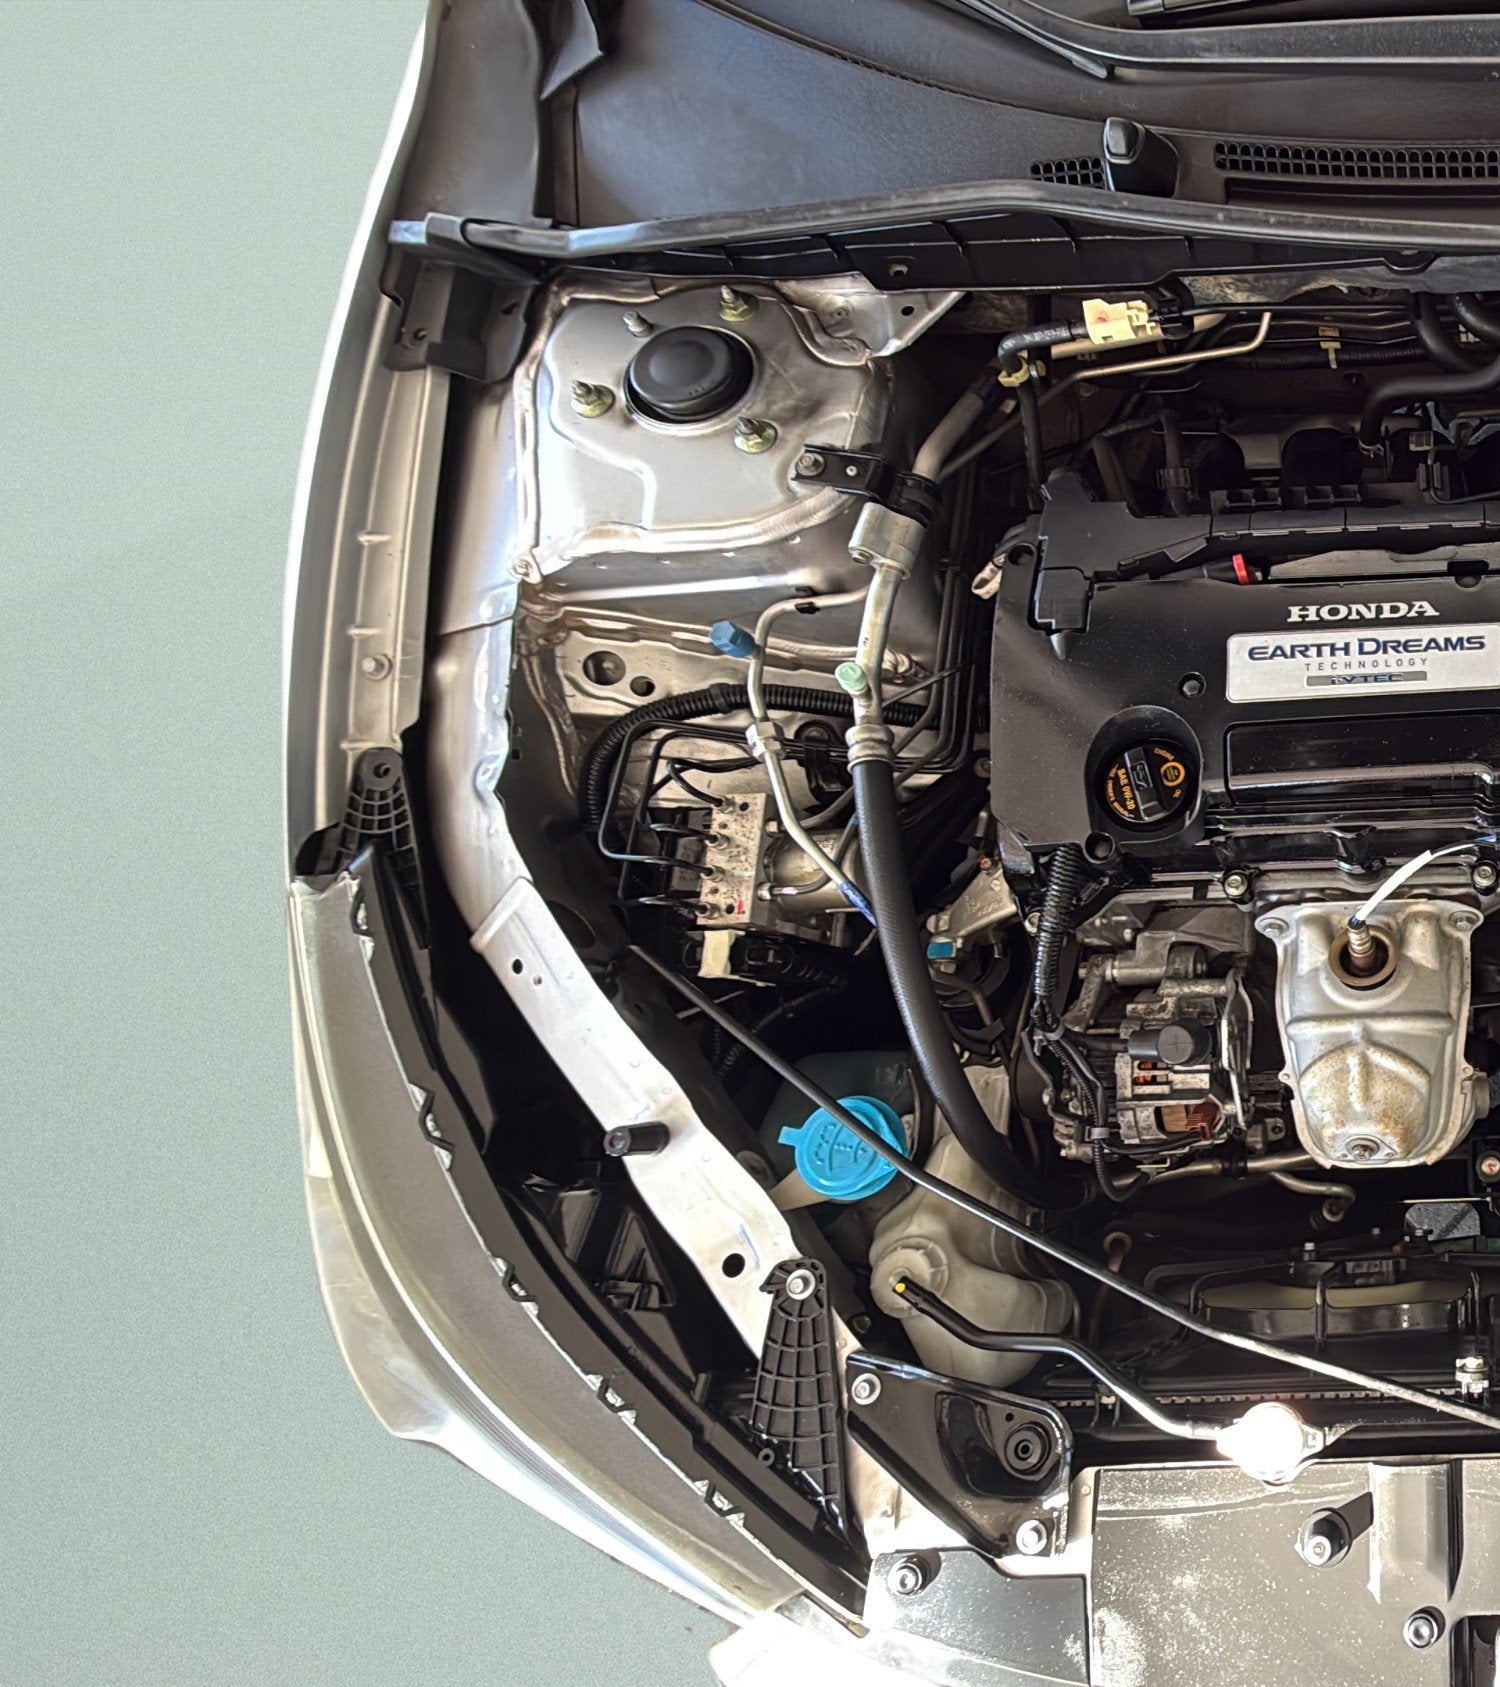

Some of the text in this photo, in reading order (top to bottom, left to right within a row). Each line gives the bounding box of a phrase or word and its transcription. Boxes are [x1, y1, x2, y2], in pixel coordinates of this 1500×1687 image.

[1286, 600, 1440, 623] HONDA
[1247, 634, 1486, 662] EARTH DREAMS
[1304, 657, 1428, 671] TECHNOLOGY
[1117, 768, 1136, 810] SAE 0W-20
